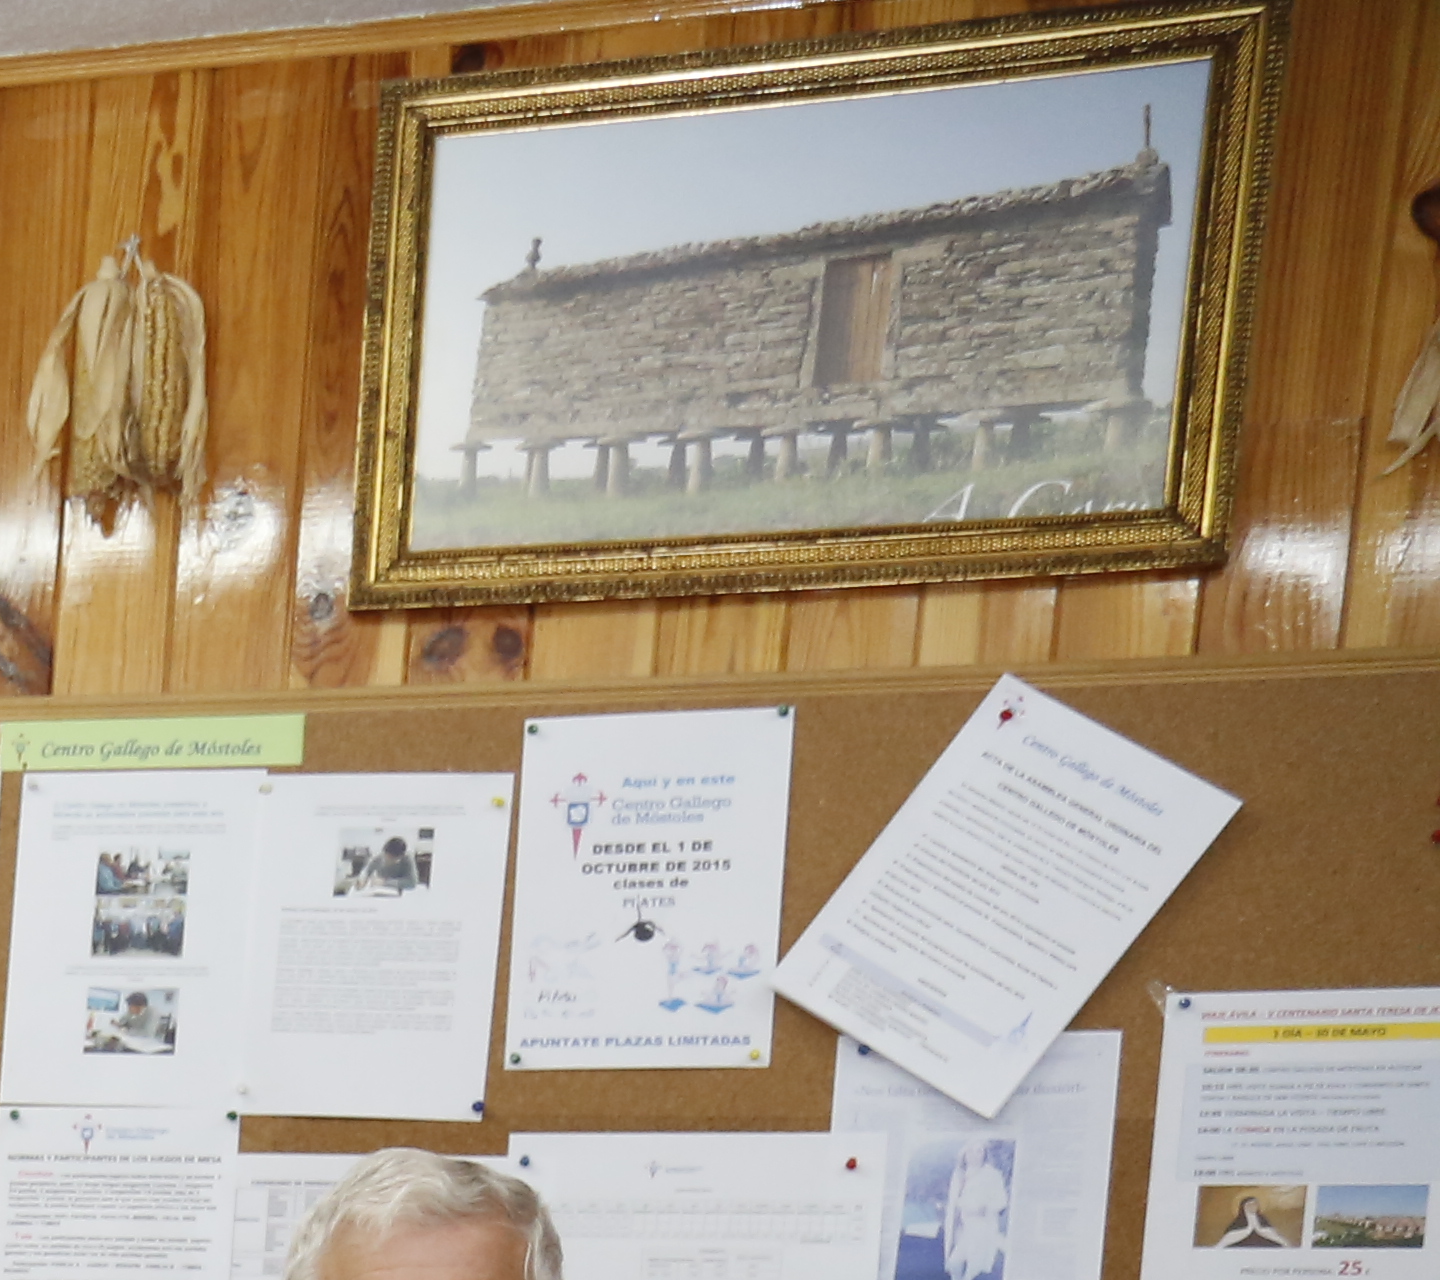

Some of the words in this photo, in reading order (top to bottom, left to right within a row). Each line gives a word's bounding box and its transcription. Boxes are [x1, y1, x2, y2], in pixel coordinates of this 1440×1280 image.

[42, 740, 95, 758] Centro
[100, 739, 160, 761] Gallego
[165, 739, 183, 757] de
[187, 737, 262, 757] Móstoles
[663, 779, 671, 789] y
[676, 777, 695, 785] en
[701, 775, 735, 785] este
[612, 798, 665, 810] Centro
[670, 796, 732, 811] Gallego
[612, 813, 630, 825] de
[592, 843, 646, 855] DESDE
[651, 842, 671, 854] EL
[678, 841, 684, 852] 1
[691, 841, 713, 852] DE
[581, 862, 660, 875] OCTUBRE
[666, 861, 687, 872] DE
[692, 859, 731, 871] 2015
[613, 878, 664, 889] clases
[669, 877, 689, 888] de
[520, 1037, 600, 1048] APUNTATE
[605, 1036, 663, 1047] PLAZAS
[668, 1035, 752, 1046] LIMITADAS
[1338, 1260, 1362, 1276] 25
